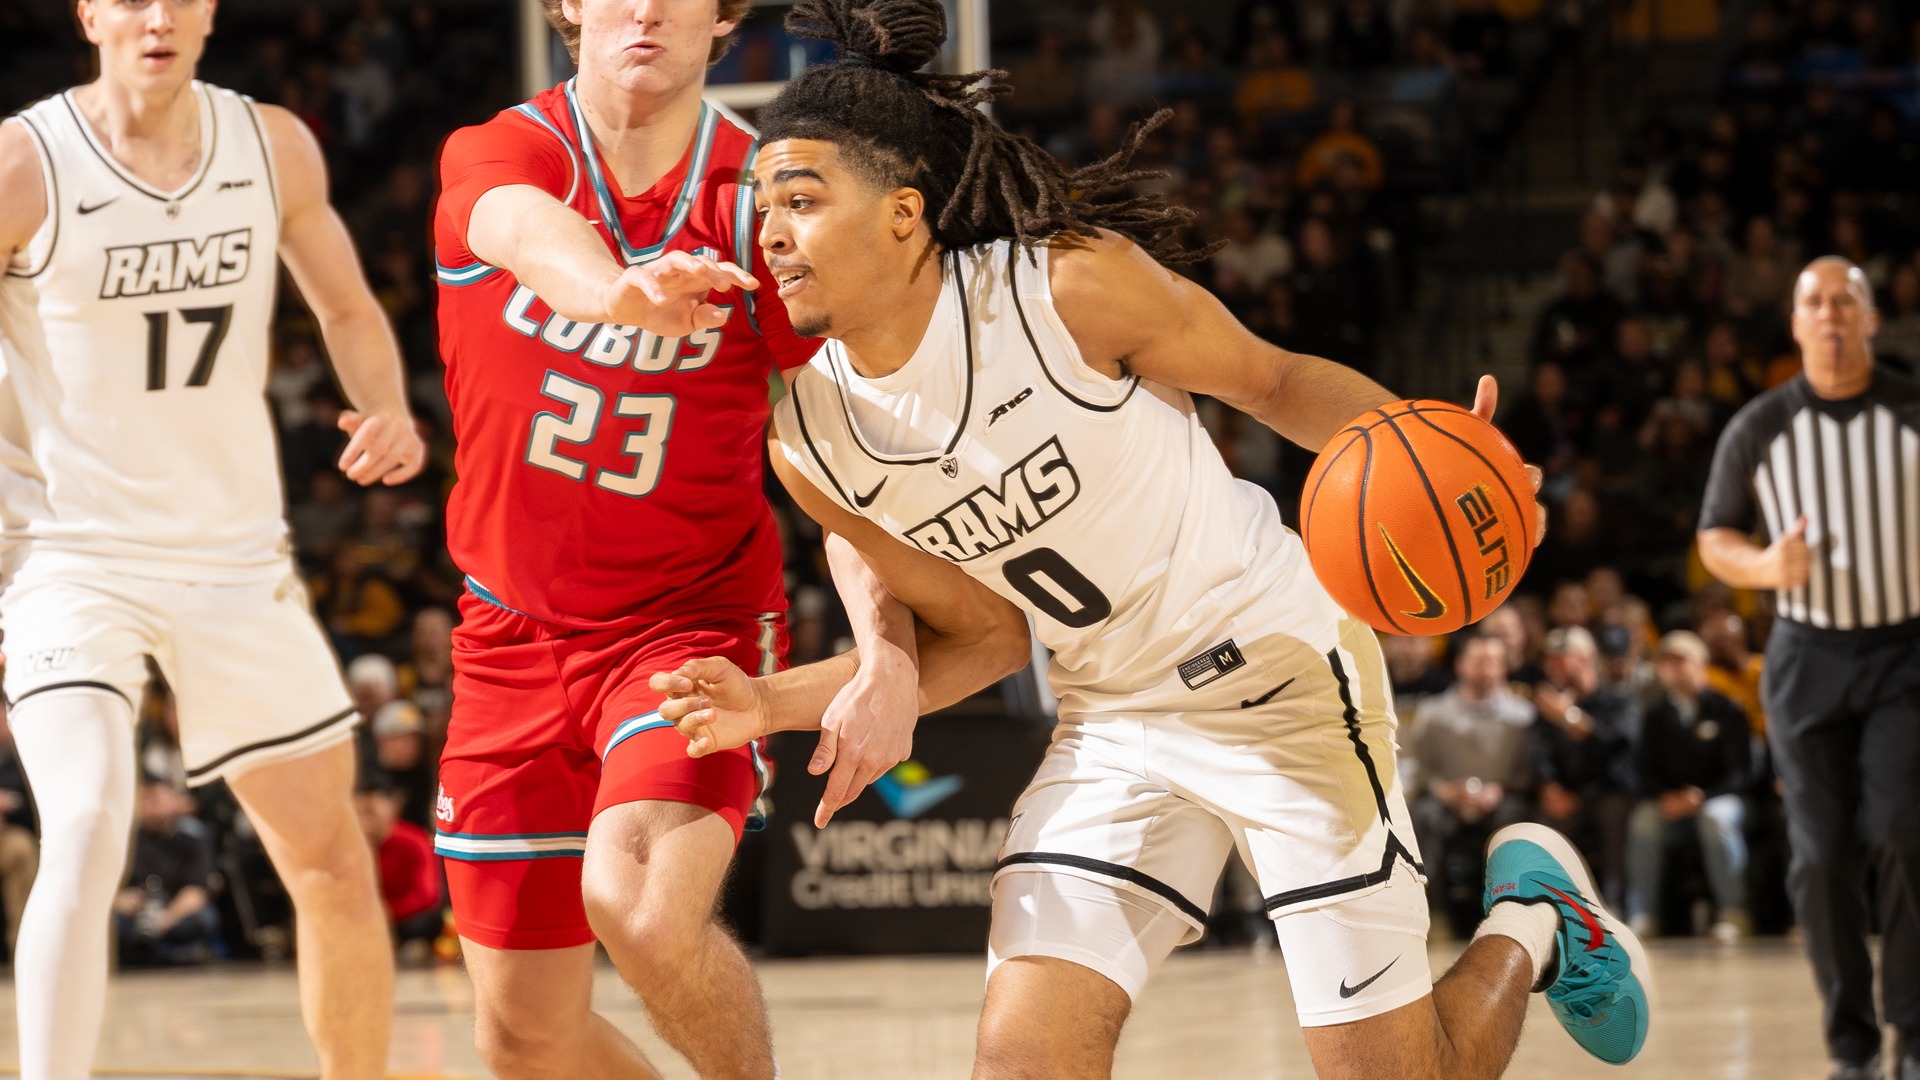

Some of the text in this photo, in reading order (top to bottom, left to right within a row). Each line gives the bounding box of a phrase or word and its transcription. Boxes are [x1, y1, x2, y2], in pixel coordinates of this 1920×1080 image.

[98, 227, 252, 300] RAMS
[141, 303, 234, 392] 17
[524, 368, 679, 499] 23
[902, 433, 1080, 562] RAMS
[1455, 484, 1510, 600] ELITE
[1001, 547, 1112, 628] 0
[1219, 651, 1234, 666] M
